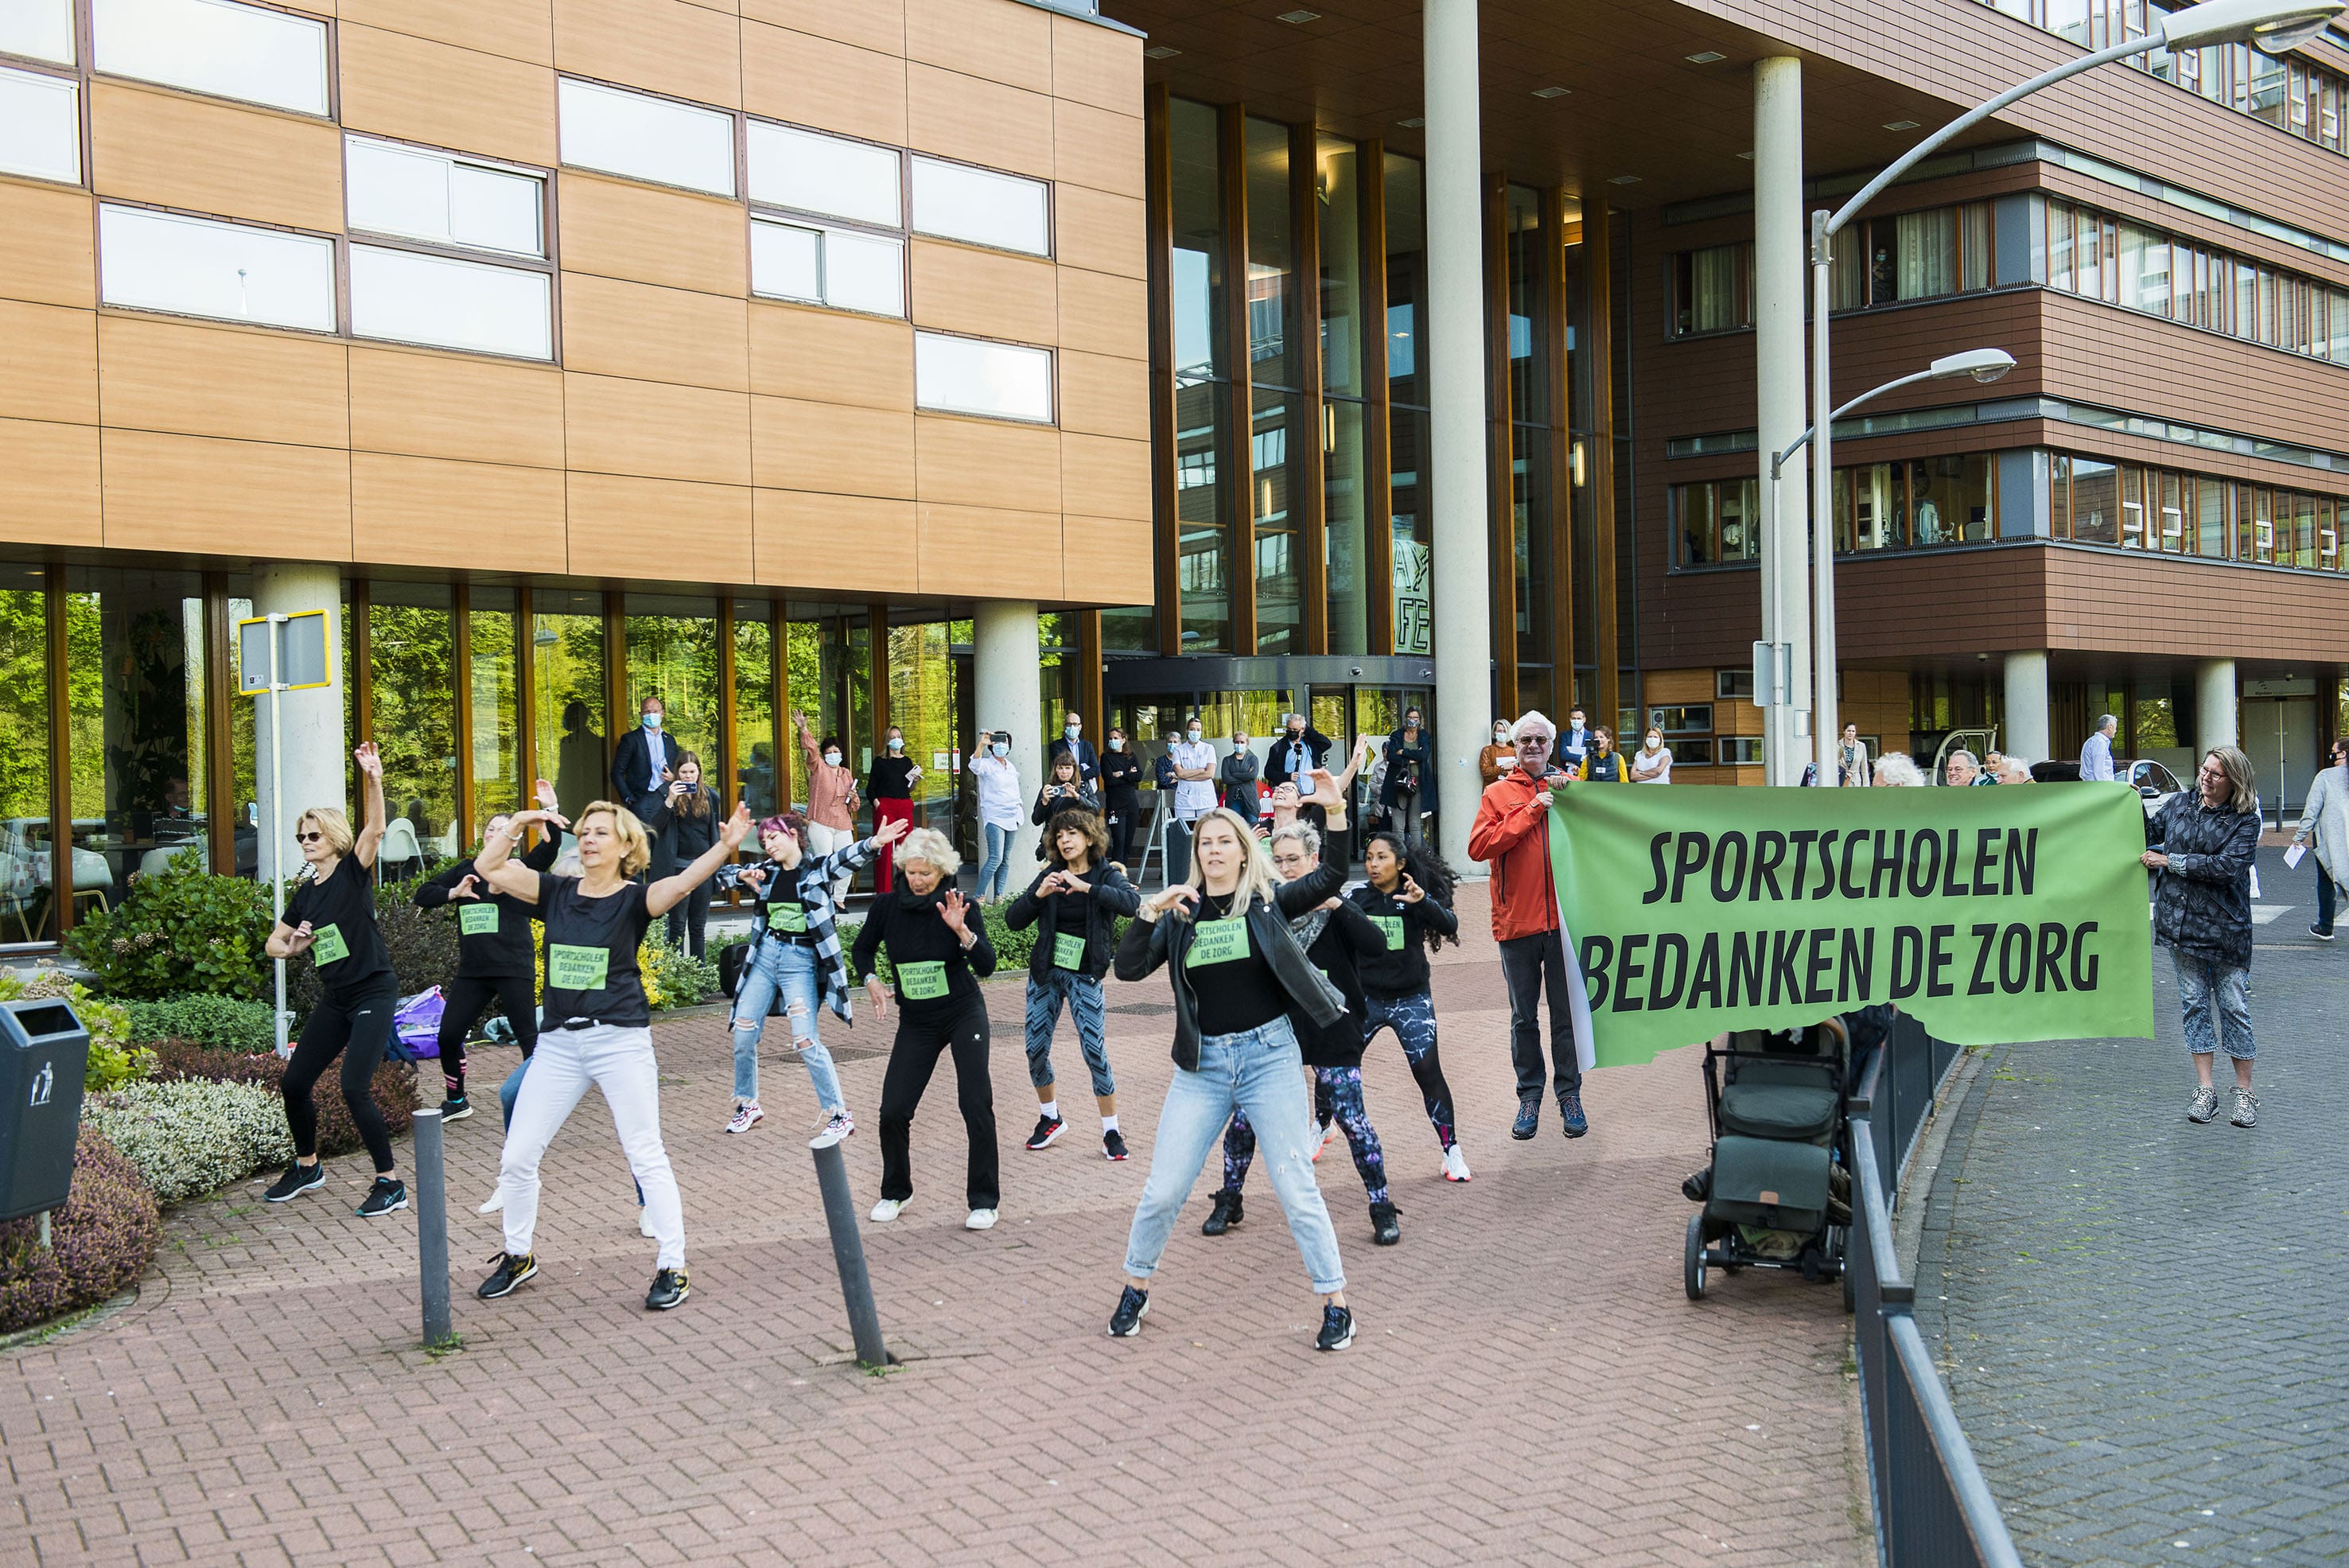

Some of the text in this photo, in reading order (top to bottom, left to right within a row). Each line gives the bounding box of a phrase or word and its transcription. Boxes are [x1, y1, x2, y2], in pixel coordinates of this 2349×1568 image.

[1643, 828, 2038, 904] SPORTSCHOLEN
[1196, 923, 1242, 936] ORTSCHOLEN
[1194, 934, 1235, 948] BEDANKEN
[1201, 946, 1233, 959] DE ZORG
[558, 962, 596, 974] BEDANKEN
[1579, 921, 2099, 1013] BEDANKEN DE ZORG
[562, 975, 591, 985] DE ZORG
[906, 975, 937, 986] BEDANKEN
[912, 986, 936, 996] DE ZORG
